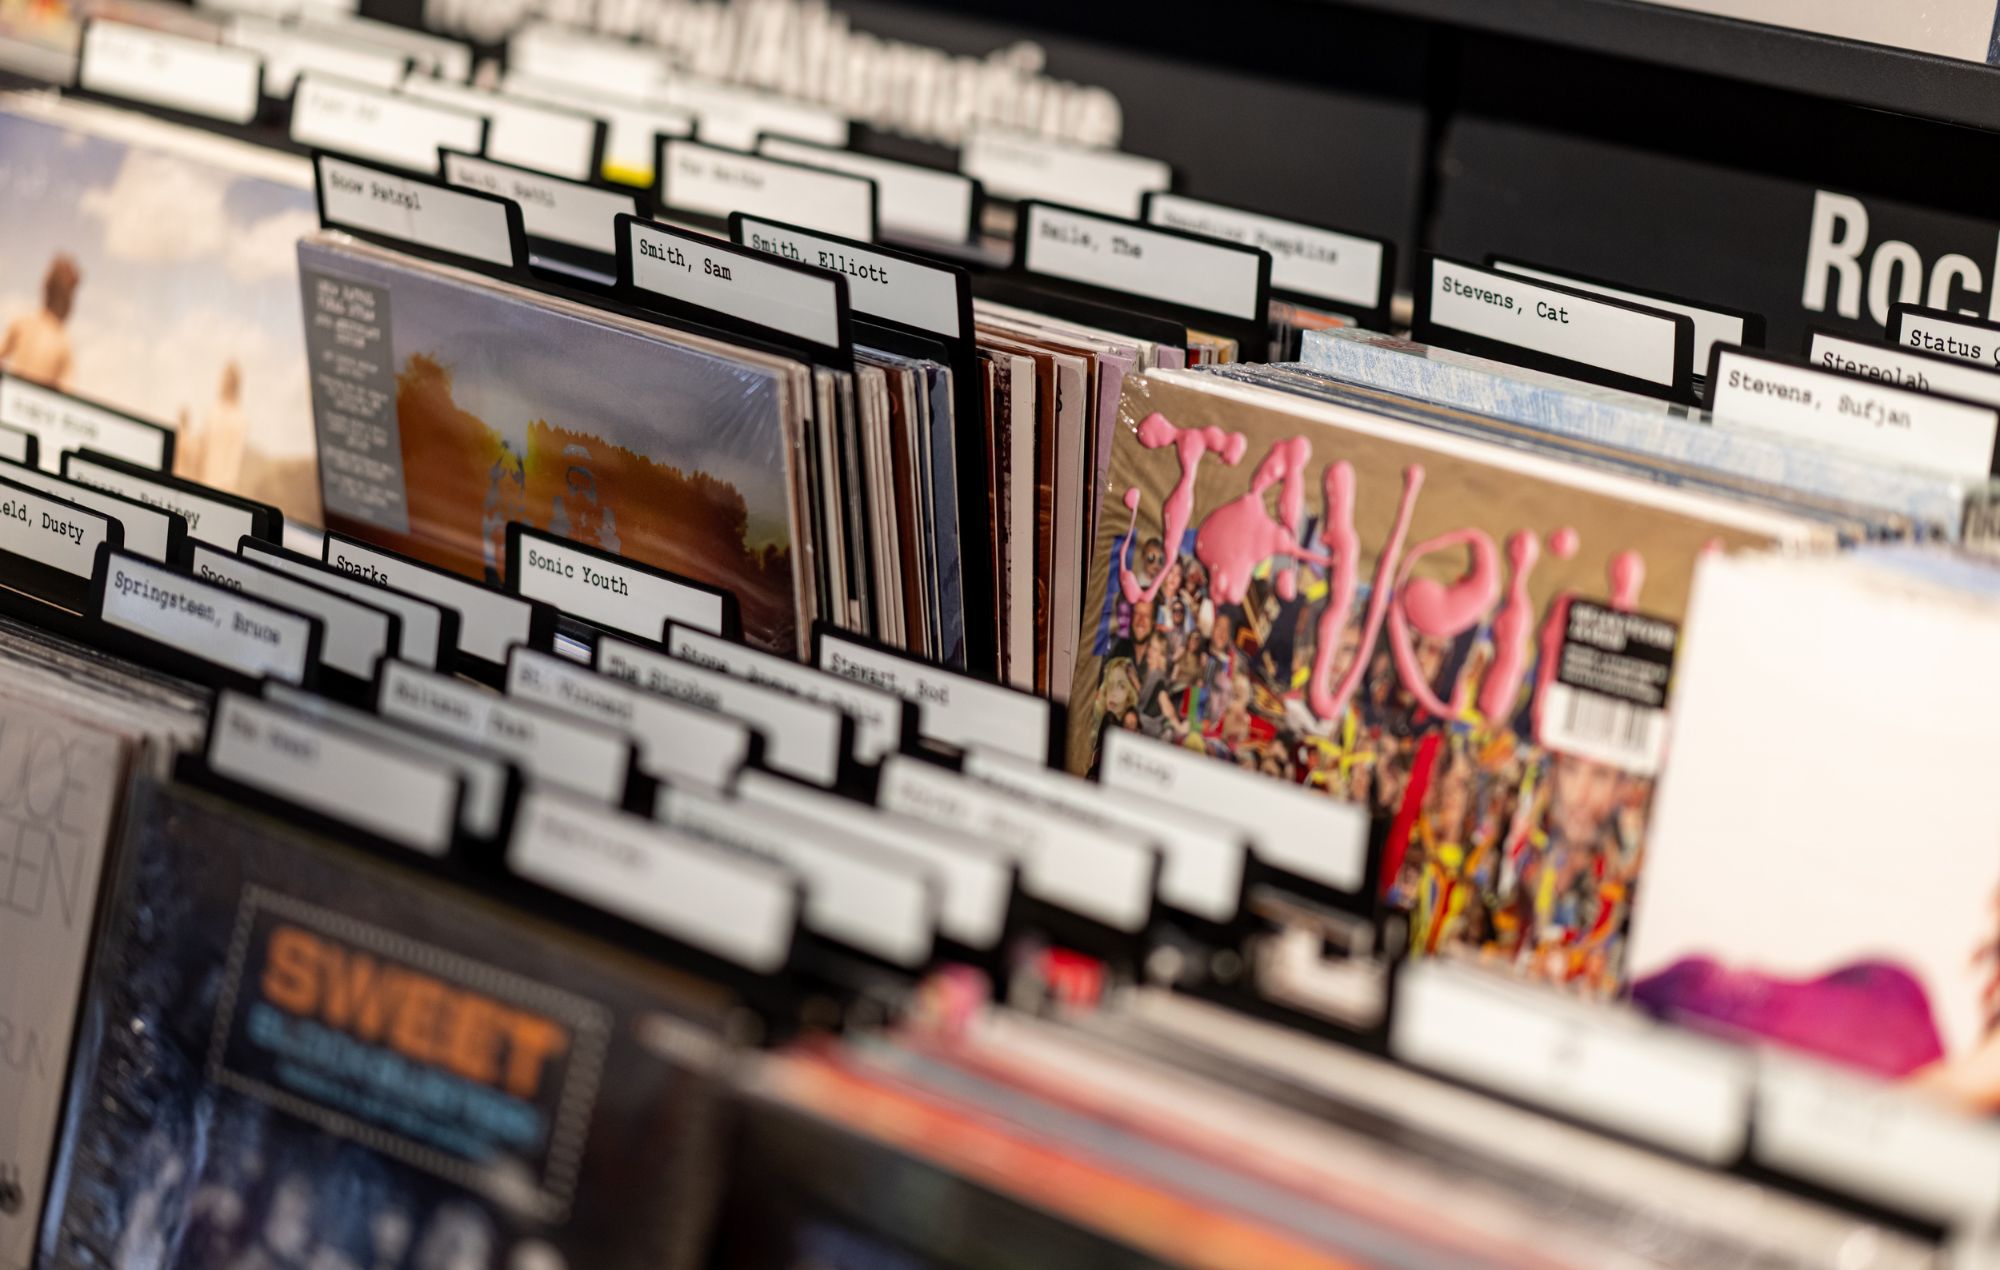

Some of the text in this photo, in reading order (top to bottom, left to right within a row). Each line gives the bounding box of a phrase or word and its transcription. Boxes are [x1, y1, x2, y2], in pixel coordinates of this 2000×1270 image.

[639, 238, 733, 281] Smith, Sam
[752, 233, 889, 285] Smith, Elliott
[1802, 189, 2000, 328] Roc
[1442, 276, 1569, 324] Stevens, Cat
[1909, 328, 1981, 359] Status
[1822, 351, 1930, 392] Stereolab
[1728, 370, 1912, 429] Stevens, Sufjan
[0, 499, 84, 545] eld, Dusty
[336, 554, 389, 587] Sparks
[528, 549, 629, 597] Sonic Youth
[114, 570, 282, 646] Springsteen, Bruce
[261, 925, 571, 1102] SWEET
